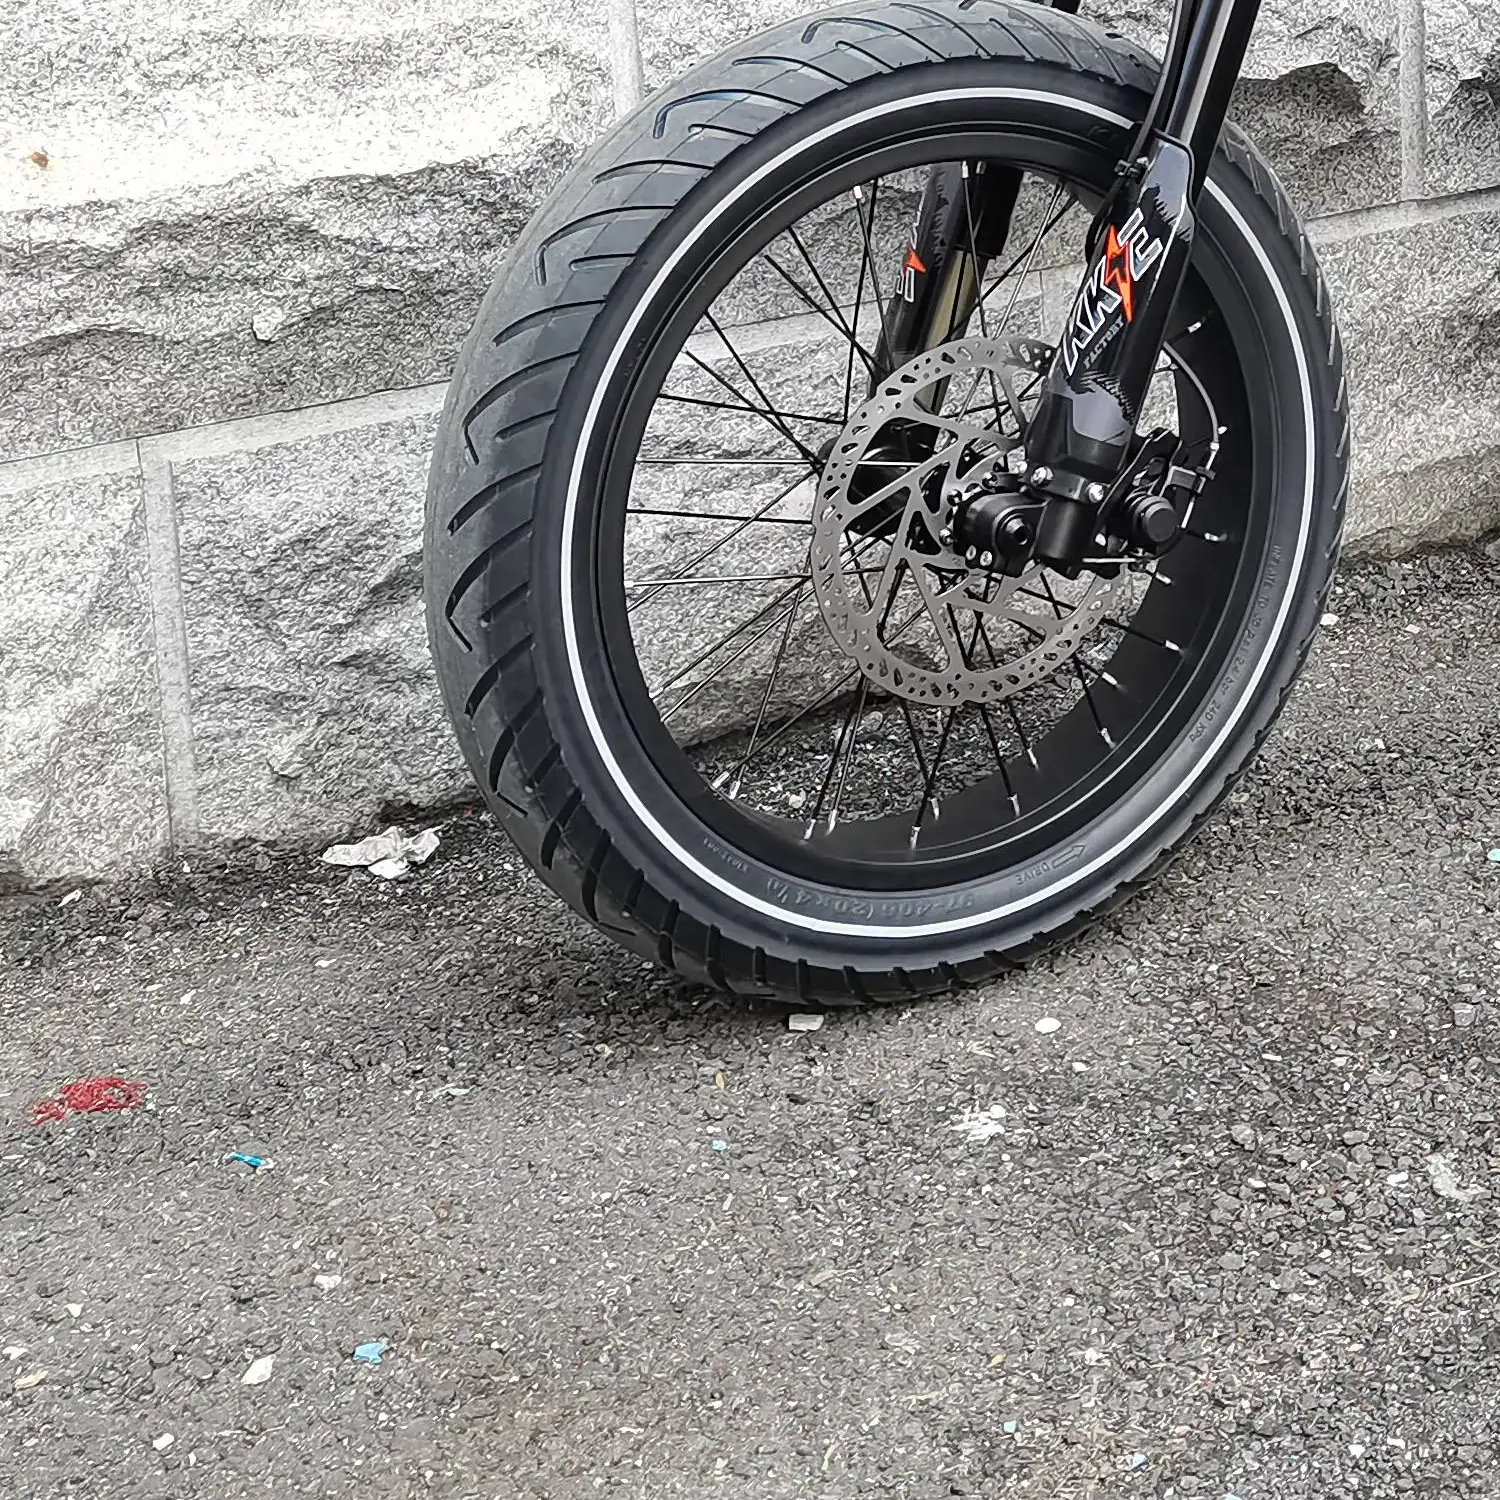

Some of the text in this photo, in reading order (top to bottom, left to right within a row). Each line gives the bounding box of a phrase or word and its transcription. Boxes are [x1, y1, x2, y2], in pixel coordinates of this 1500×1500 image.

[1083, 314, 1125, 369] FACTORY
[1204, 699, 1221, 722] 240
[1014, 861, 1051, 885] DRIVE
